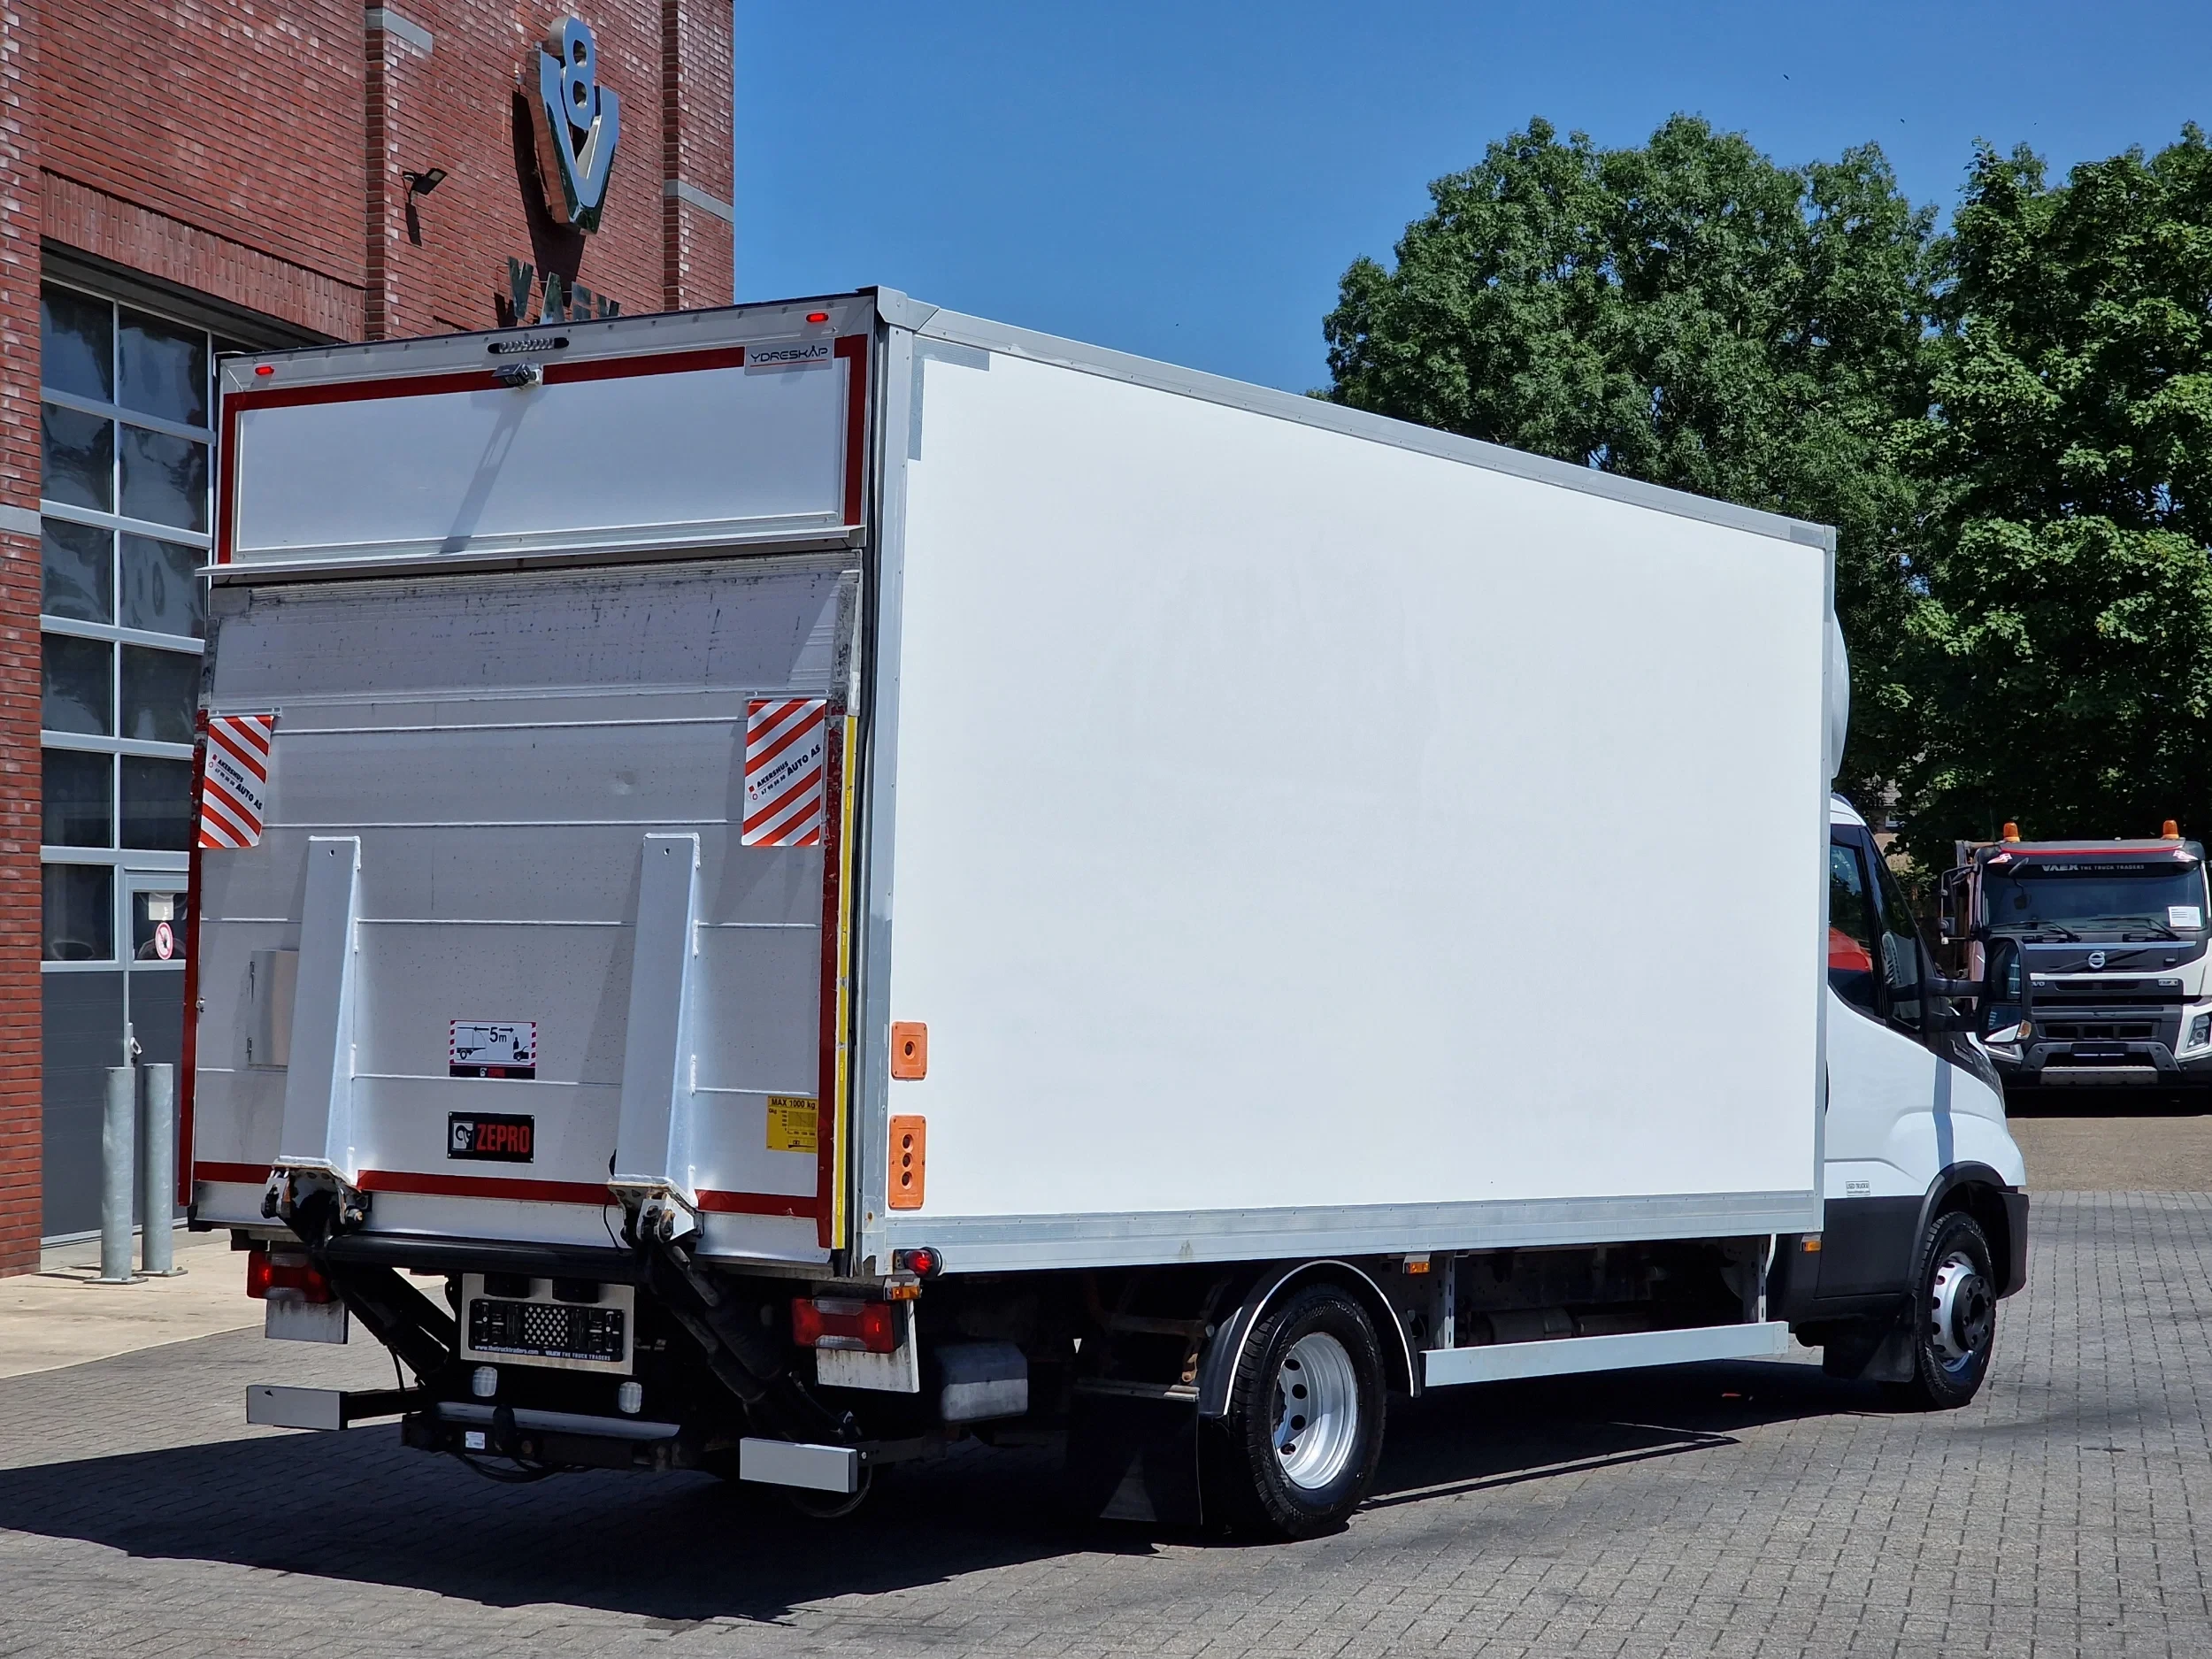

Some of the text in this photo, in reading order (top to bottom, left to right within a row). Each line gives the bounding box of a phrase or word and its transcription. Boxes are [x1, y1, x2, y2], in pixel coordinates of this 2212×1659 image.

[218, 759, 244, 783] AKERSHUS
[787, 743, 821, 777] AUTO AS
[757, 760, 789, 788] AKERSHUS
[235, 783, 263, 810] AUTO AS
[772, 1098, 787, 1107] MAX
[807, 1101, 816, 1110] kg
[476, 1123, 531, 1154] ZEPRO
